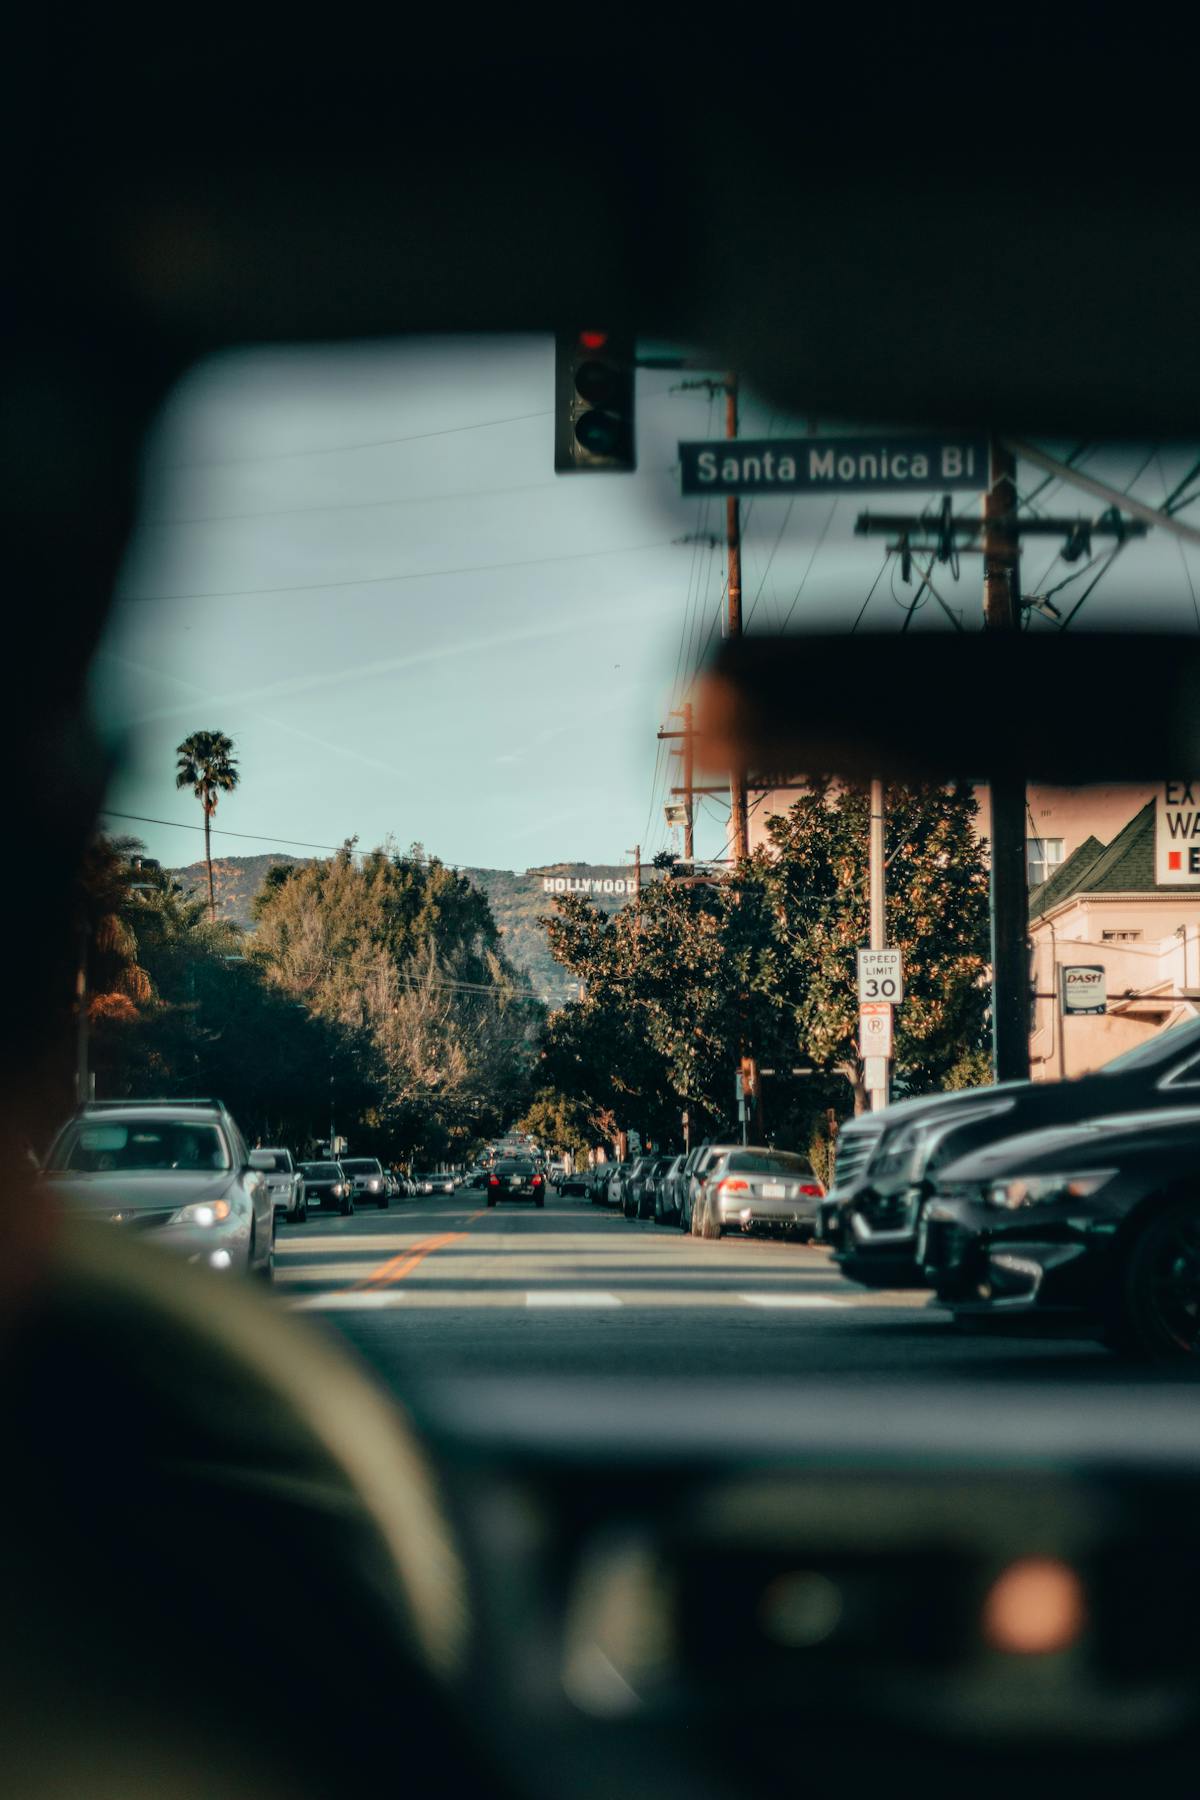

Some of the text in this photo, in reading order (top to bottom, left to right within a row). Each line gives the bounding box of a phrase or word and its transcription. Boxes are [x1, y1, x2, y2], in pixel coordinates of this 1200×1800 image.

[697, 447, 974, 482] Santa Monica Bl
[543, 877, 638, 893] HOLLYWOOD
[862, 955, 898, 963] SPEED
[866, 966, 894, 976] LIMIT
[1067, 973, 1102, 983] DASH
[865, 979, 896, 997] 30
